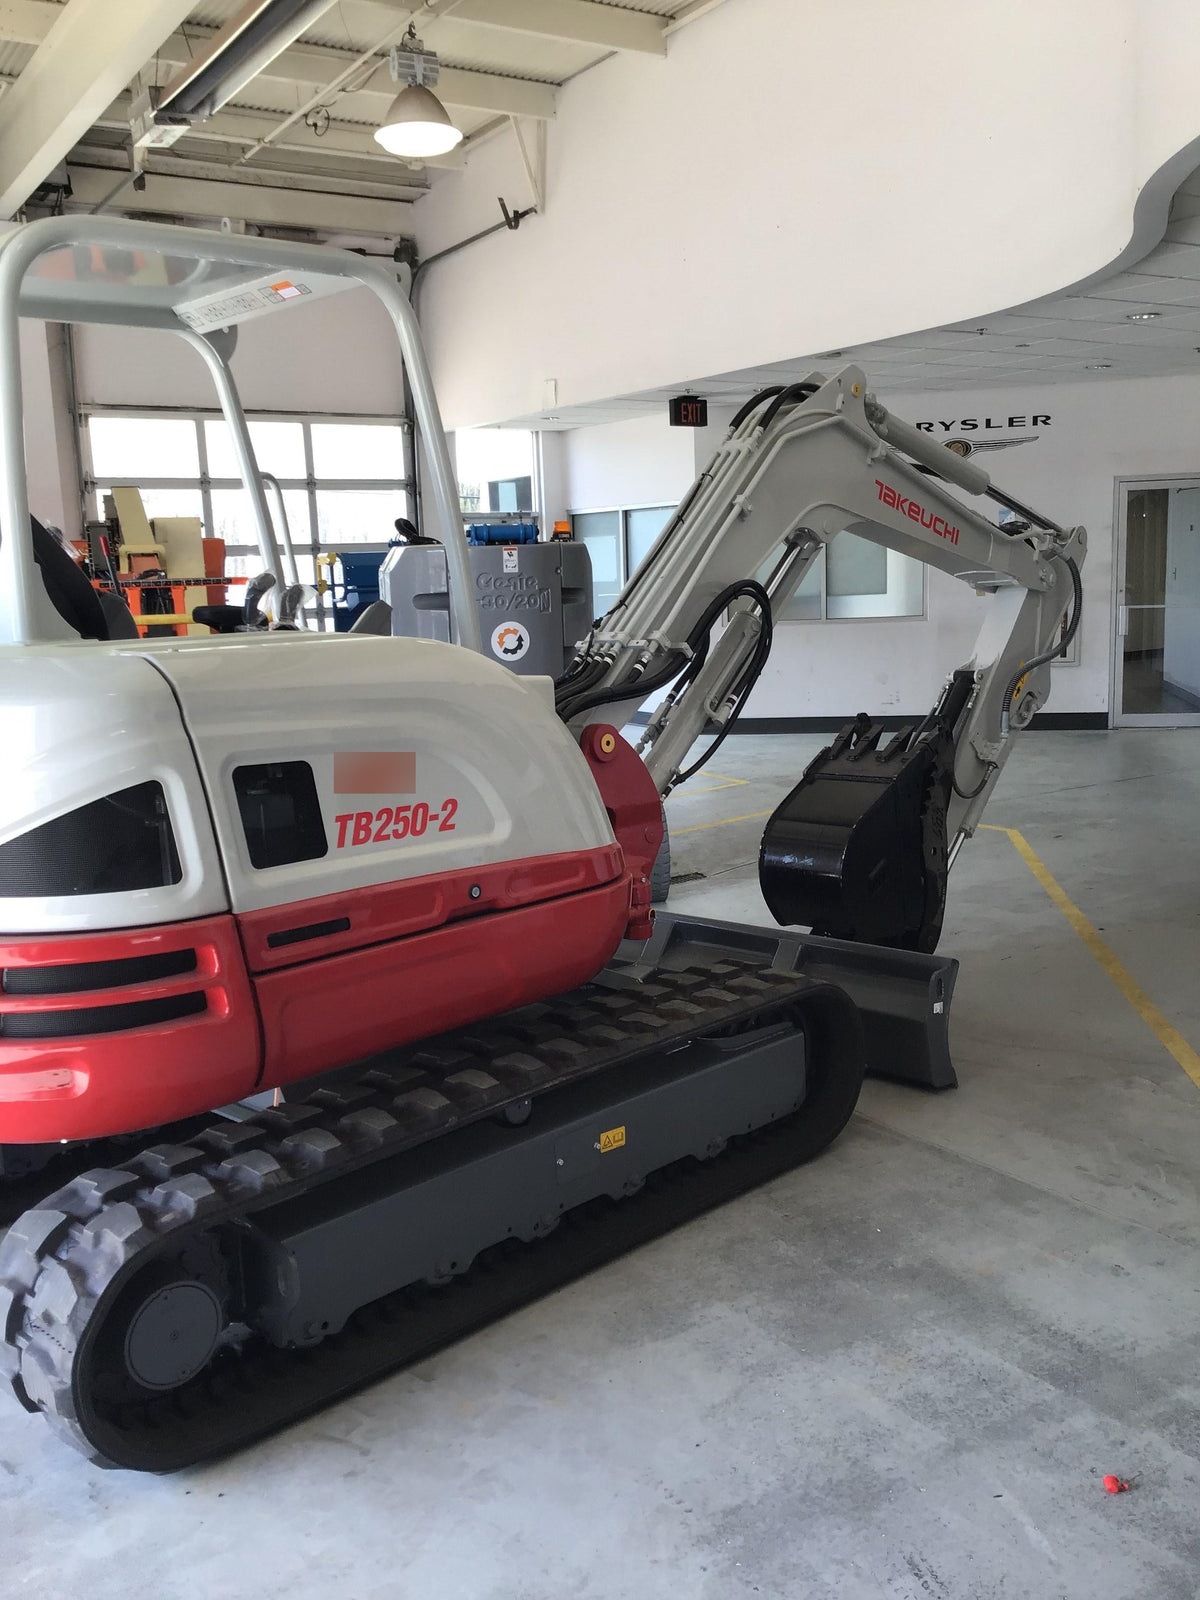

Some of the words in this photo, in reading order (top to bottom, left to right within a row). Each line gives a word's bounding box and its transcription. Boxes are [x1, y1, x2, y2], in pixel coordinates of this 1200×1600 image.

[681, 402, 702, 423] EXIT
[915, 414, 1052, 433] RYSLER
[874, 479, 960, 546] TAKEUCHI
[476, 571, 539, 591] Genie
[334, 798, 459, 849] TB250-2
